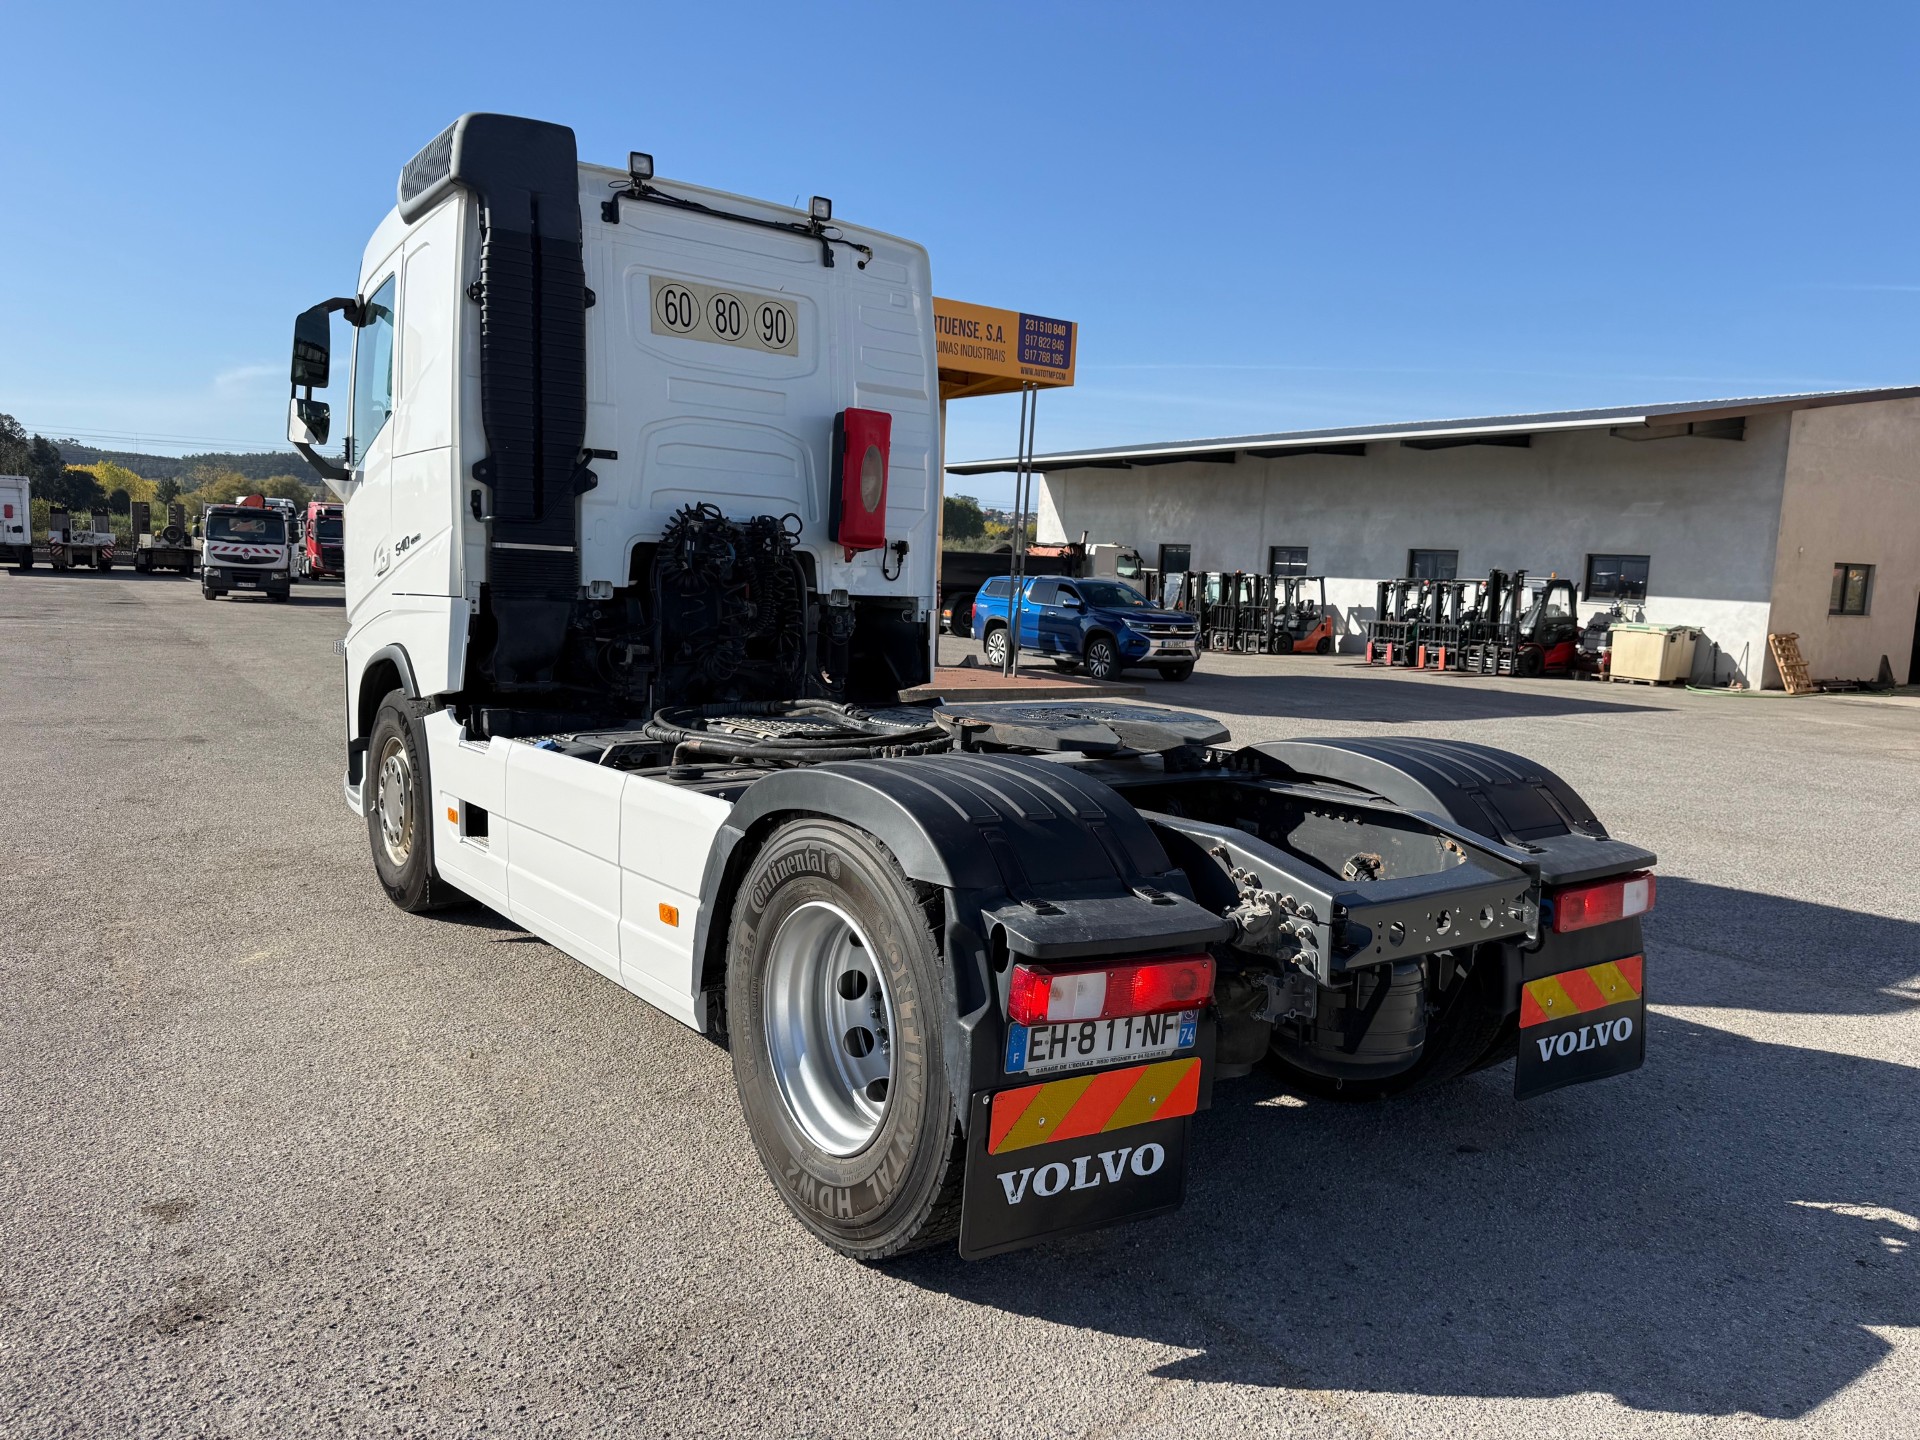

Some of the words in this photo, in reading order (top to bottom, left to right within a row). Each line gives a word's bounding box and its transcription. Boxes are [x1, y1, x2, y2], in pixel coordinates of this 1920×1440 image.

[665, 290, 692, 328] 60
[715, 298, 741, 336] 80
[762, 307, 787, 344] 90
[986, 323, 1006, 344] S.A.
[1025, 319, 1038, 331] 231
[1040, 321, 1052, 333] 510
[1053, 324, 1066, 336] 840
[960, 343, 1006, 363] INDUSTRIAIS
[1024, 349, 1037, 361] 917
[1052, 353, 1064, 365] 195
[1025, 334, 1037, 347] 917
[1038, 336, 1051, 348] 822
[1052, 339, 1065, 351] 846
[395, 535, 410, 557] 540
[750, 843, 827, 914] Continental
[1027, 1012, 1176, 1062] EH-811-NF
[1180, 1027, 1194, 1044] 74
[1536, 1017, 1633, 1063] VOLVO
[866, 918, 923, 1206] CONTINENTAL
[1013, 1052, 1020, 1064] F
[1035, 1065, 1058, 1074] GARAGE
[785, 1156, 853, 1219] HDW2
[996, 1142, 1165, 1205] VOLVO
